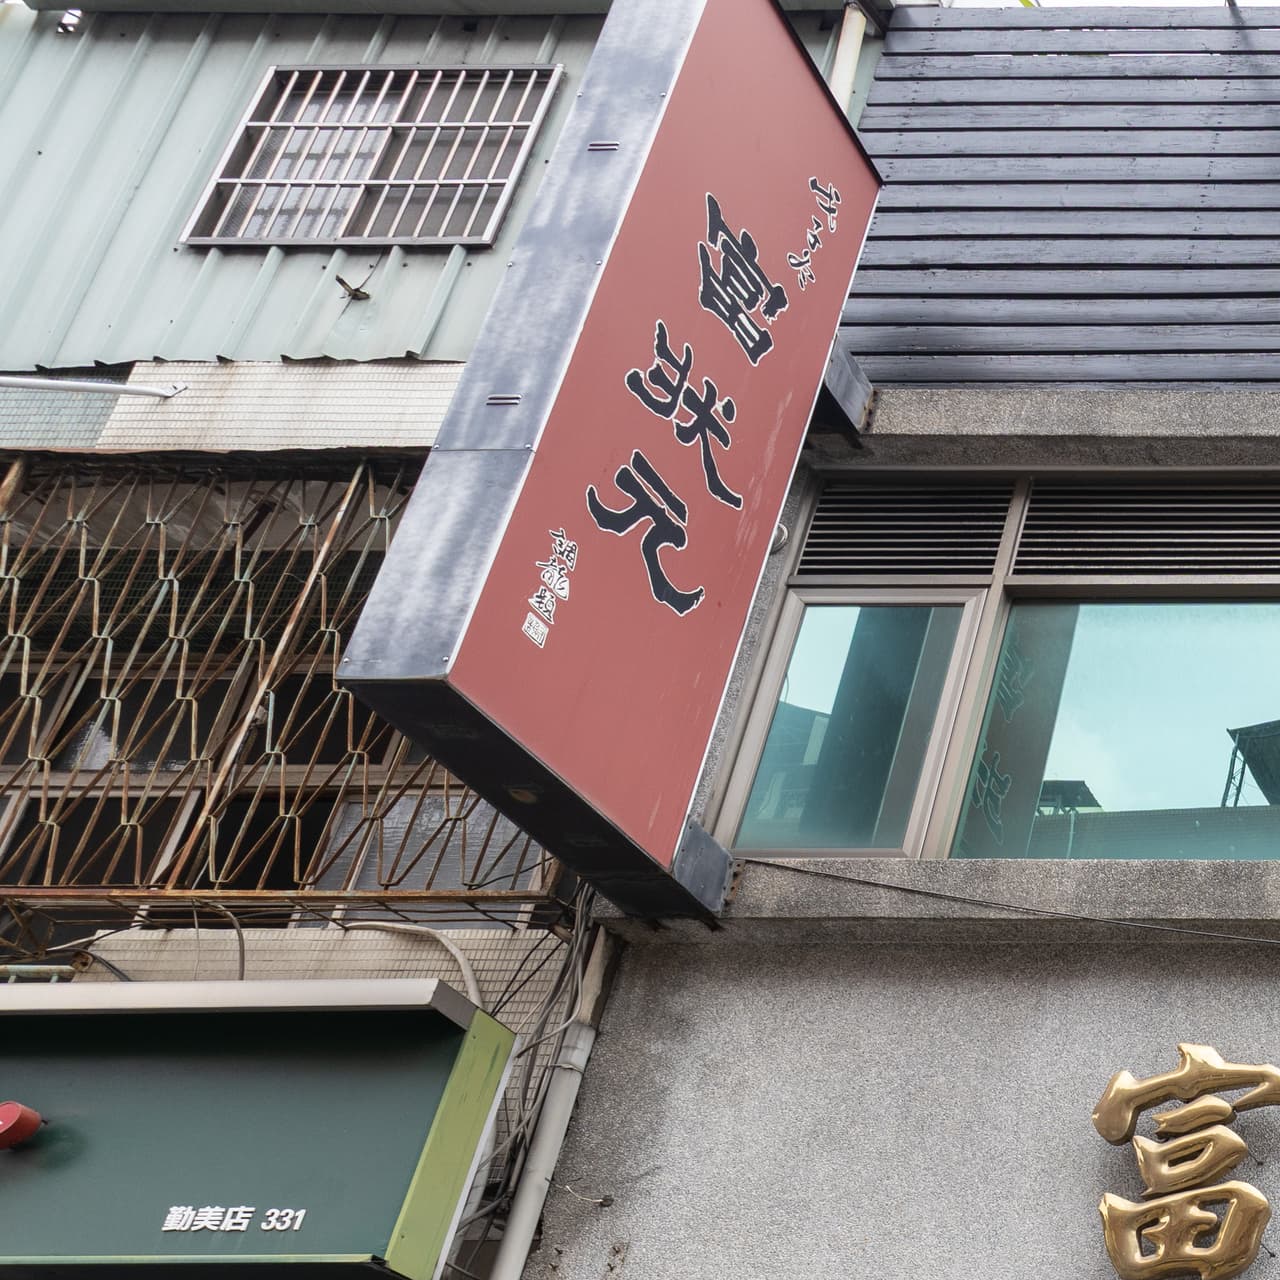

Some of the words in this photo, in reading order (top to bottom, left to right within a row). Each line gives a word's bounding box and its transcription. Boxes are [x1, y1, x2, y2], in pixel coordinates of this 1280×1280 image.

[161, 1205, 256, 1231] 勤美店
[260, 1208, 307, 1231] 331
